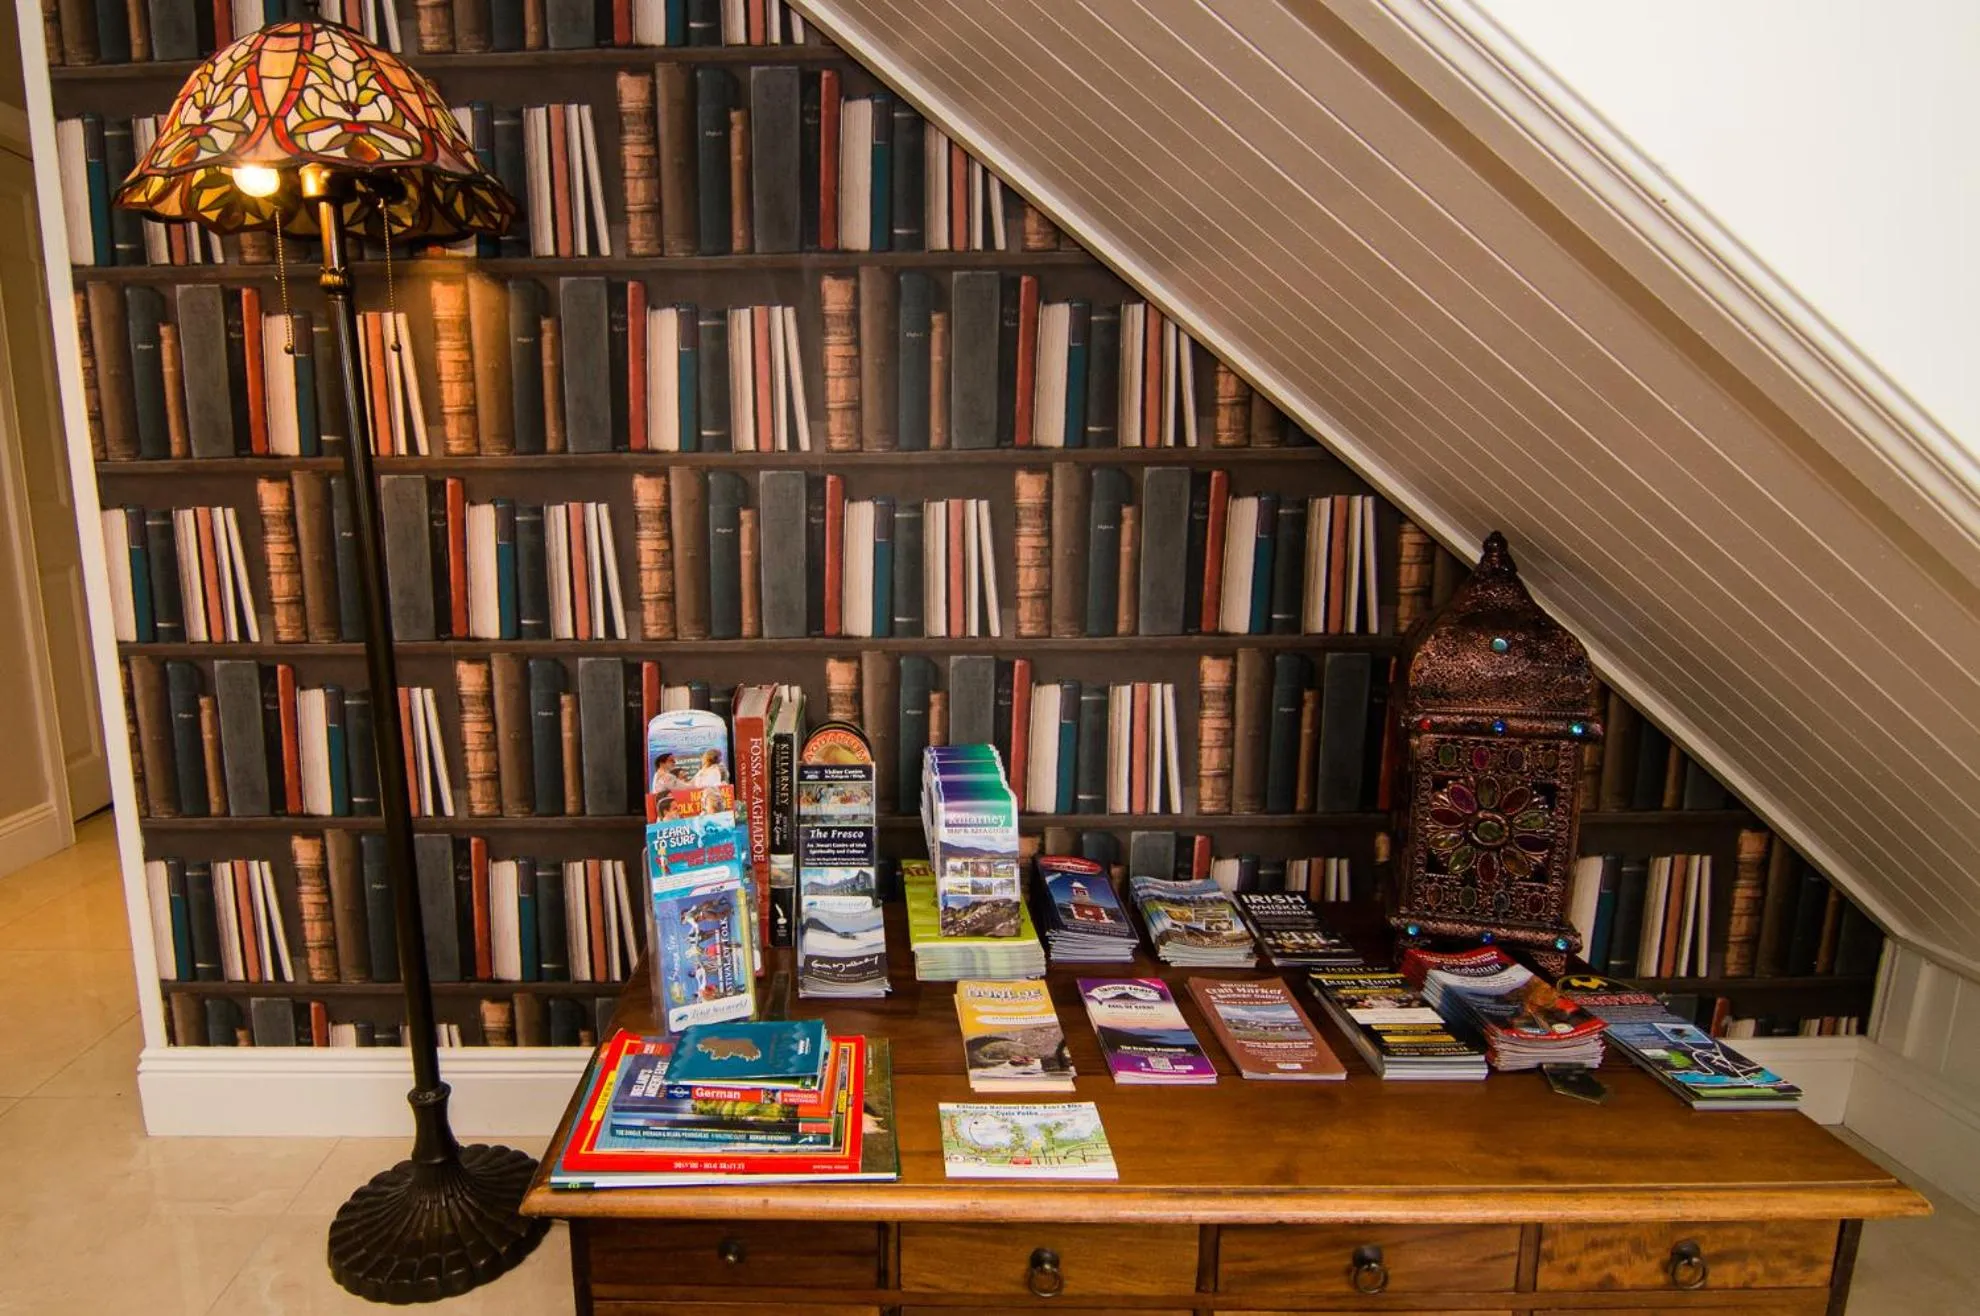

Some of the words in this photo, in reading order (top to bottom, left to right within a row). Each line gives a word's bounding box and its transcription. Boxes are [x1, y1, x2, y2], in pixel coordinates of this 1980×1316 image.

[803, 732, 868, 765] AQUARIUM
[750, 737, 761, 777] FOSSA
[780, 743, 789, 805] KILLARNEY
[948, 812, 1006, 827] Killarney
[657, 826, 690, 839] LEARN
[752, 796, 764, 862] AGHADOE
[810, 829, 829, 838] The
[831, 829, 864, 839] Fresco
[653, 840, 667, 850] TO
[670, 834, 696, 847] SURF
[1241, 894, 1305, 903] IRISH
[719, 916, 729, 942] FOLK
[696, 1087, 741, 1099] German
